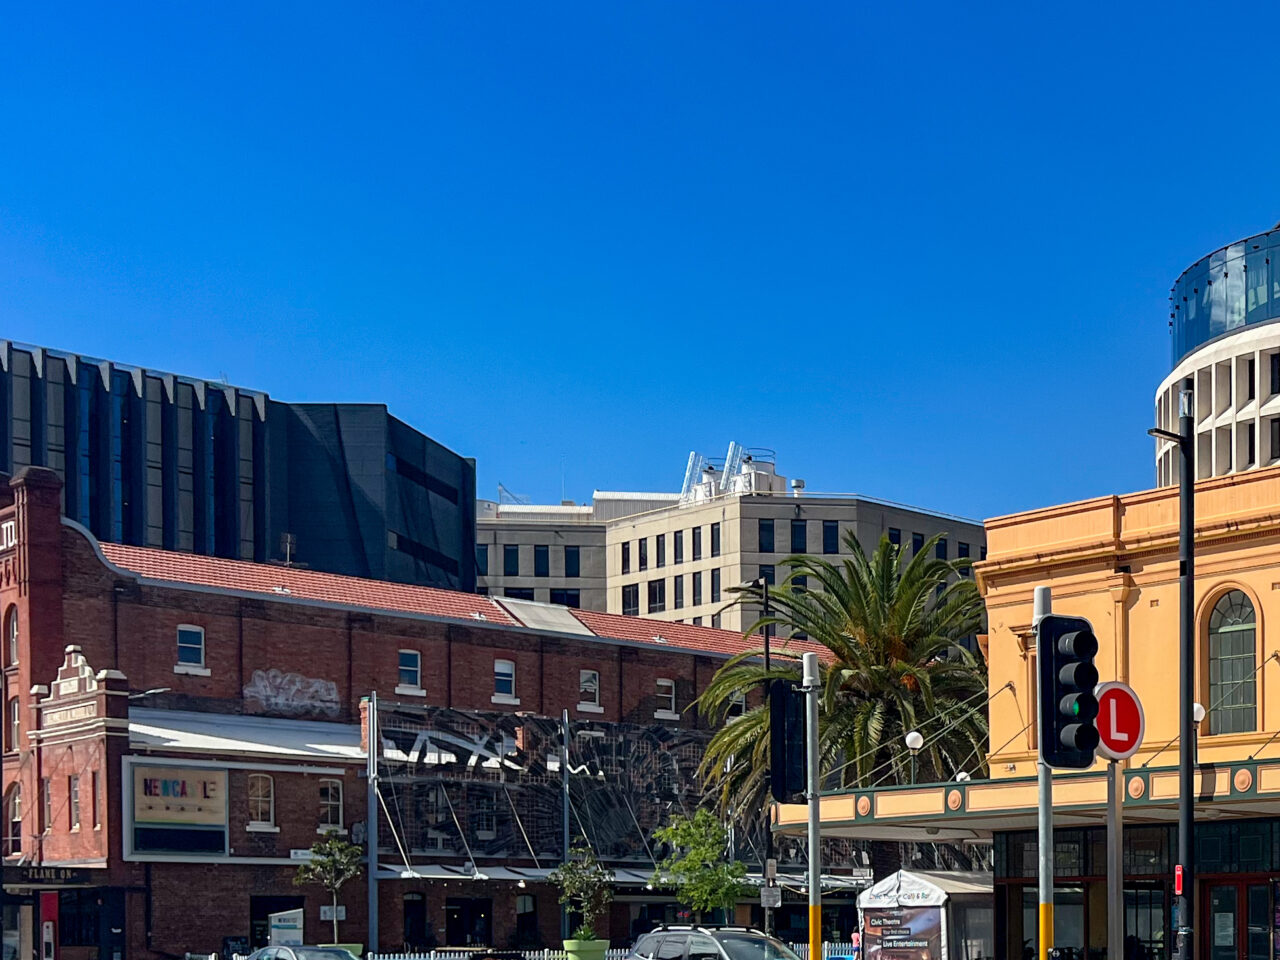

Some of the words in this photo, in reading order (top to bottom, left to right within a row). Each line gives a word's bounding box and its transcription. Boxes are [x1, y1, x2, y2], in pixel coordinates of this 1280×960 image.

[1110, 698, 1129, 741] L
[143, 778, 216, 799] NEWCALE
[870, 918, 882, 926] Civic
